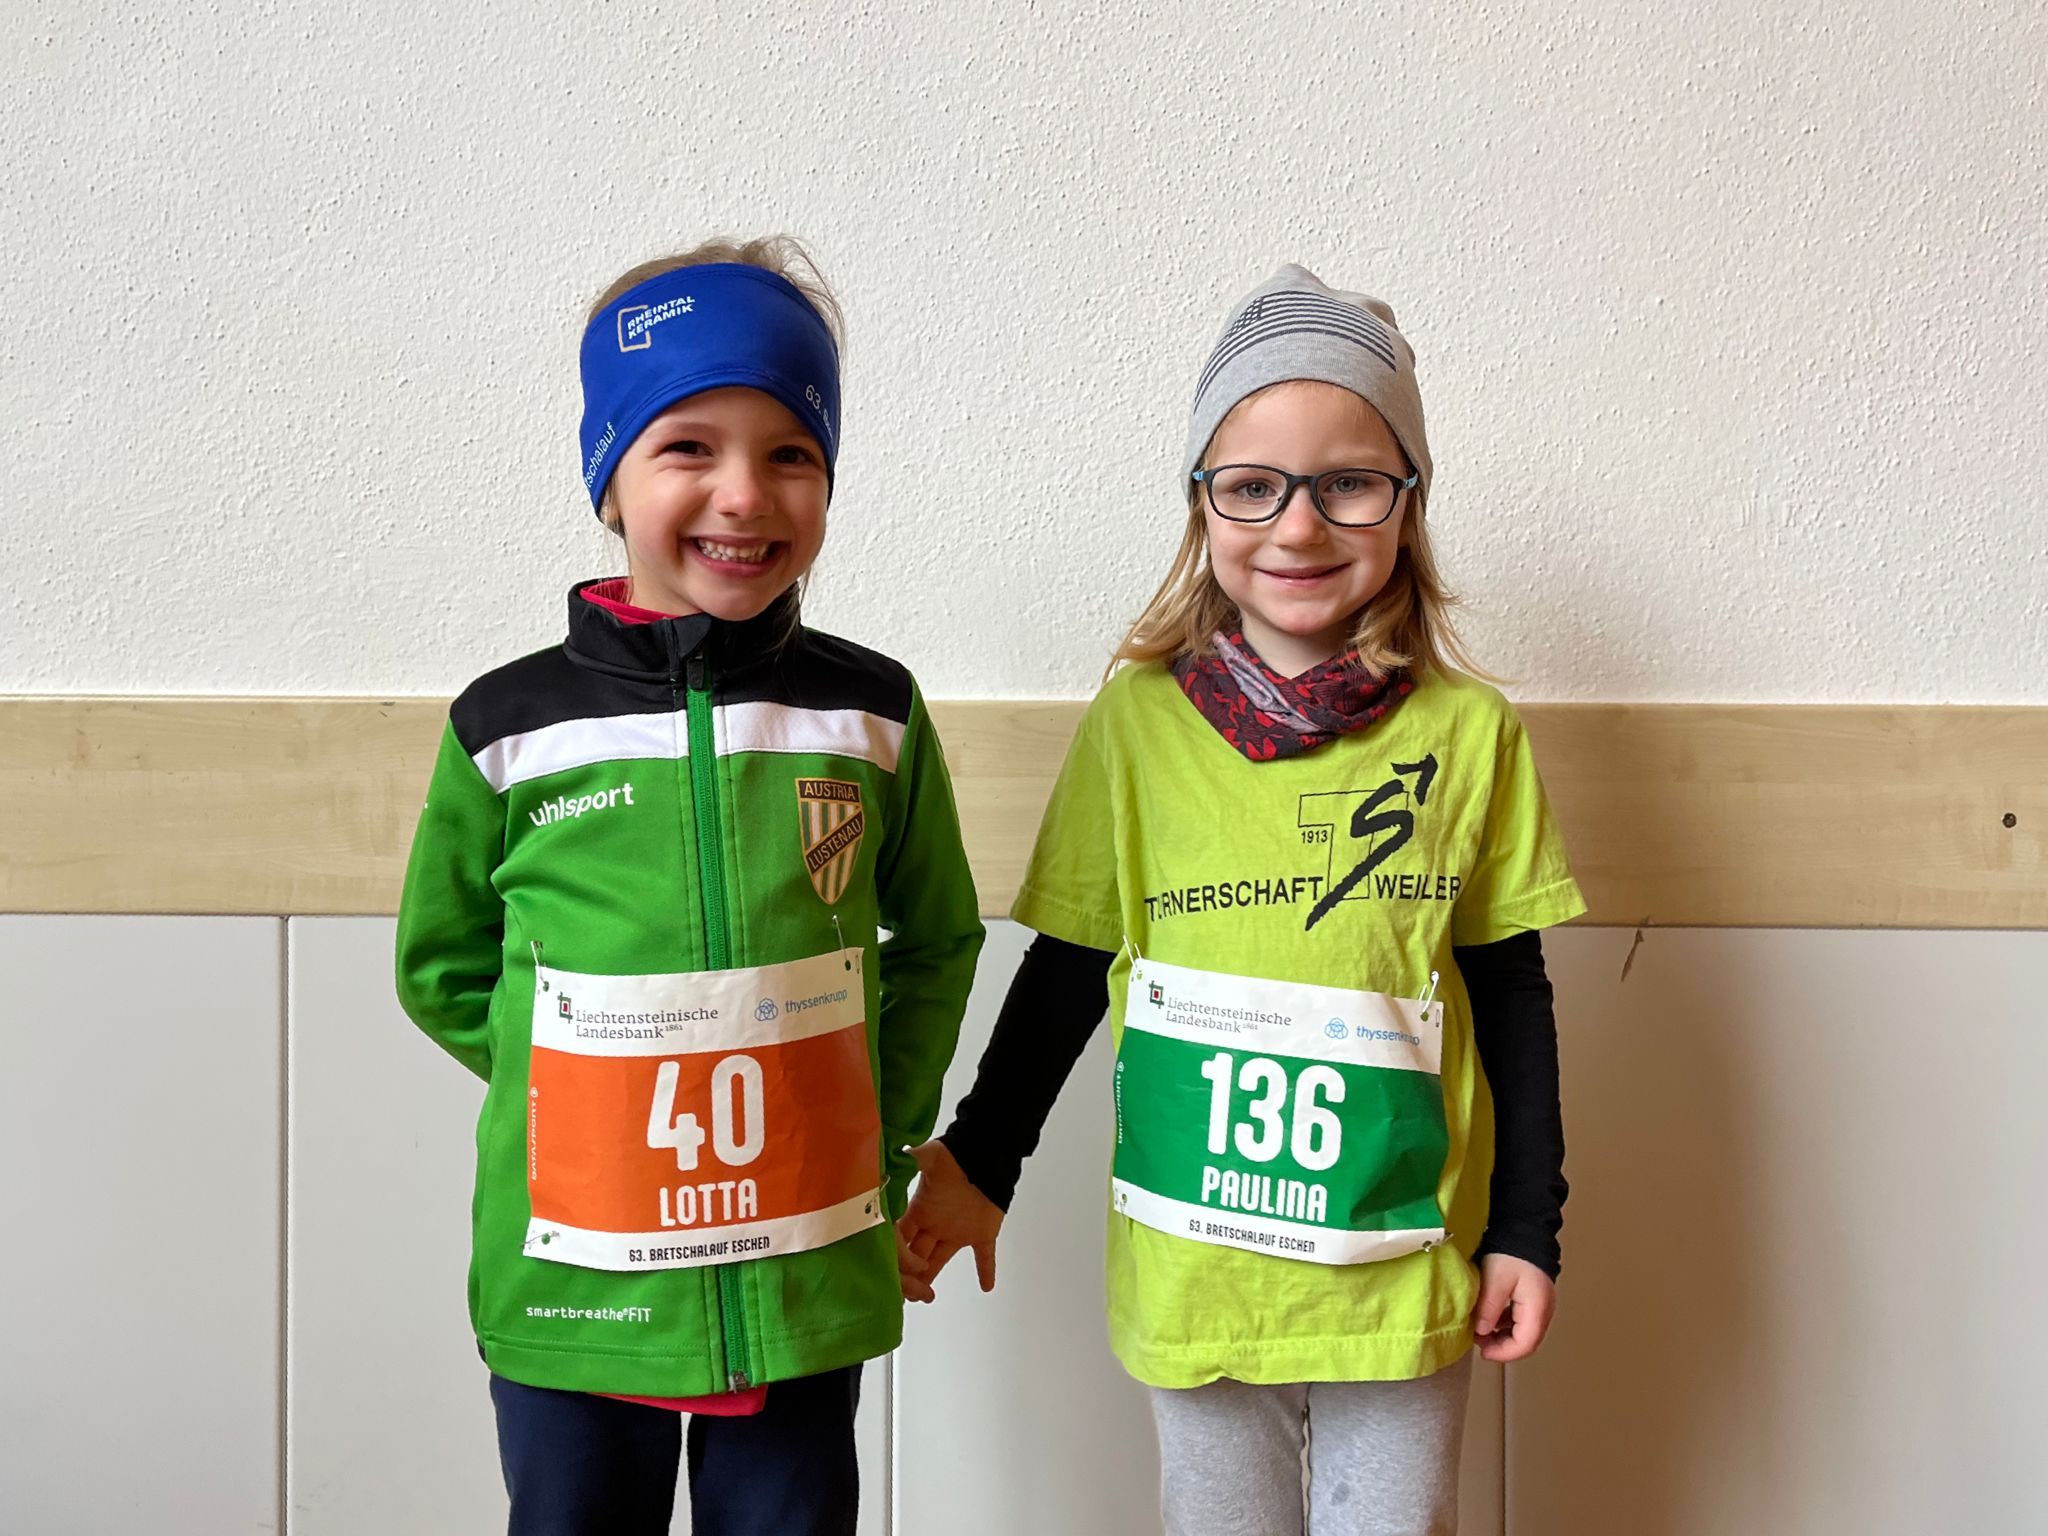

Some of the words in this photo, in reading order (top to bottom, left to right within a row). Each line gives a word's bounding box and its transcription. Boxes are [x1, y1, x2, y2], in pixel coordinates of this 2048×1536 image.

[628, 296, 696, 330] RHEINTAL
[628, 304, 694, 339] KERAMIK
[528, 782, 635, 827] uhlsport
[804, 782, 856, 800] AUSTRIA
[808, 817, 862, 870] LUSTENAU
[1301, 830, 1328, 844] 1913
[1144, 875, 1323, 922] TRNERSCHAFT
[1374, 873, 1462, 901] WEILER
[576, 1007, 719, 1025] Liechtensteinische
[785, 988, 848, 1014] thyssenkrupp
[1167, 996, 1292, 1027] Liechtensteinische
[576, 1024, 665, 1040] Landesbank
[1165, 1010, 1242, 1034] Landesbank
[647, 1054, 765, 1172] 40
[1200, 1052, 1347, 1171] 136
[659, 1178, 758, 1227] LOTTA
[1201, 1165, 1328, 1223] PAULINA
[628, 1248, 647, 1262] 63.
[649, 1241, 729, 1262] BRETSCHALAUF
[732, 1235, 771, 1254] ESCHEN
[1188, 1218, 1204, 1234] 63.
[1206, 1222, 1277, 1248] BRETSCHALAUF
[1278, 1236, 1316, 1254] ESCHEN
